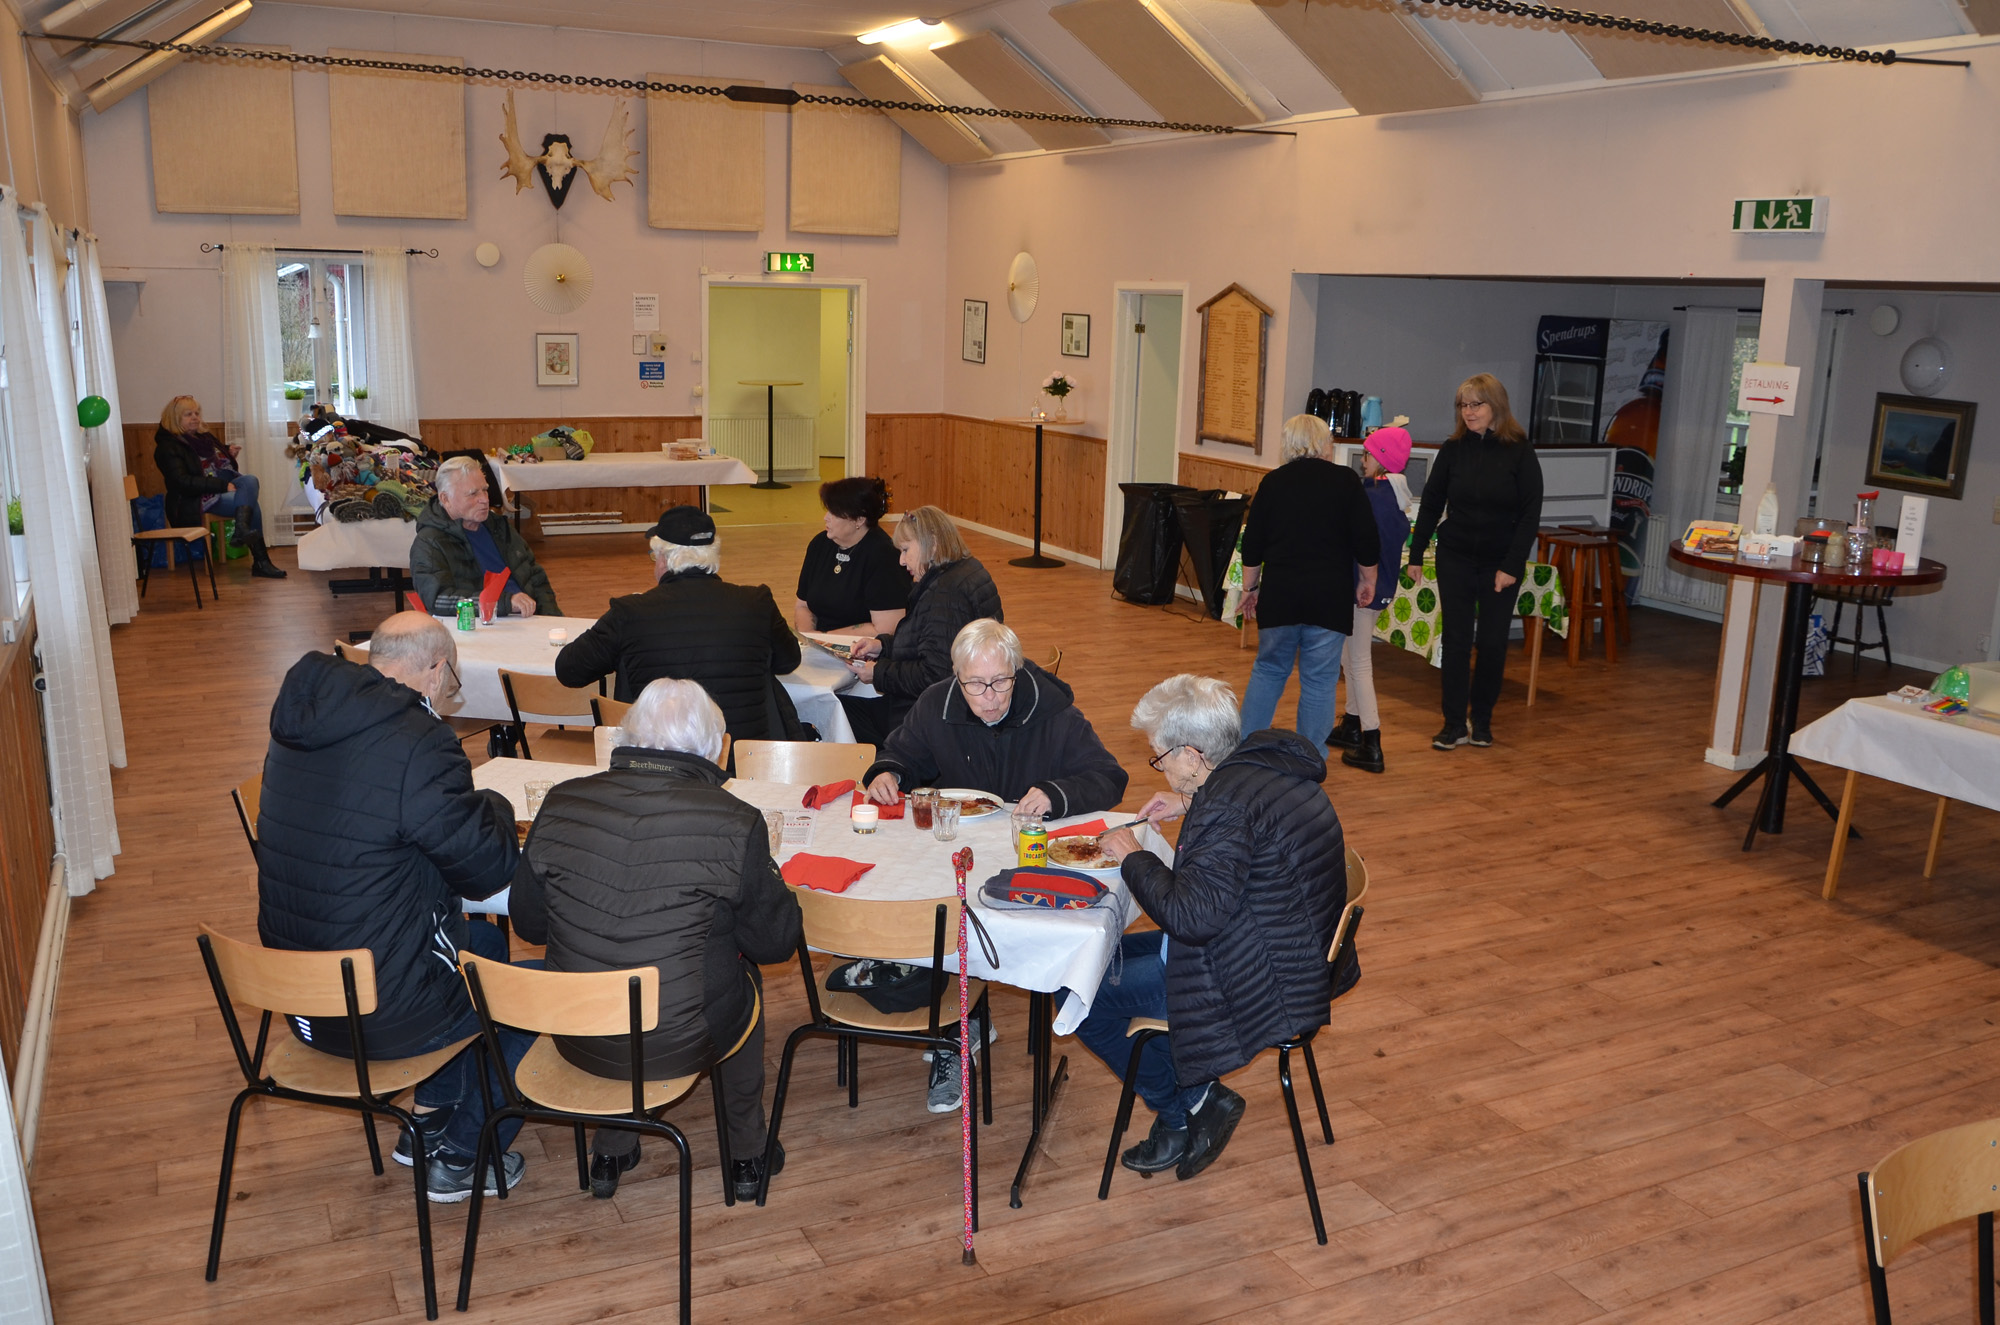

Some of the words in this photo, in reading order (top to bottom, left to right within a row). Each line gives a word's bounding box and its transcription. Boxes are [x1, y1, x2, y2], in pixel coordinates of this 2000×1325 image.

[1541, 324, 1597, 349] Spendrups
[1744, 377, 1789, 390] BETALNING
[629, 760, 672, 771] Deerhunter
